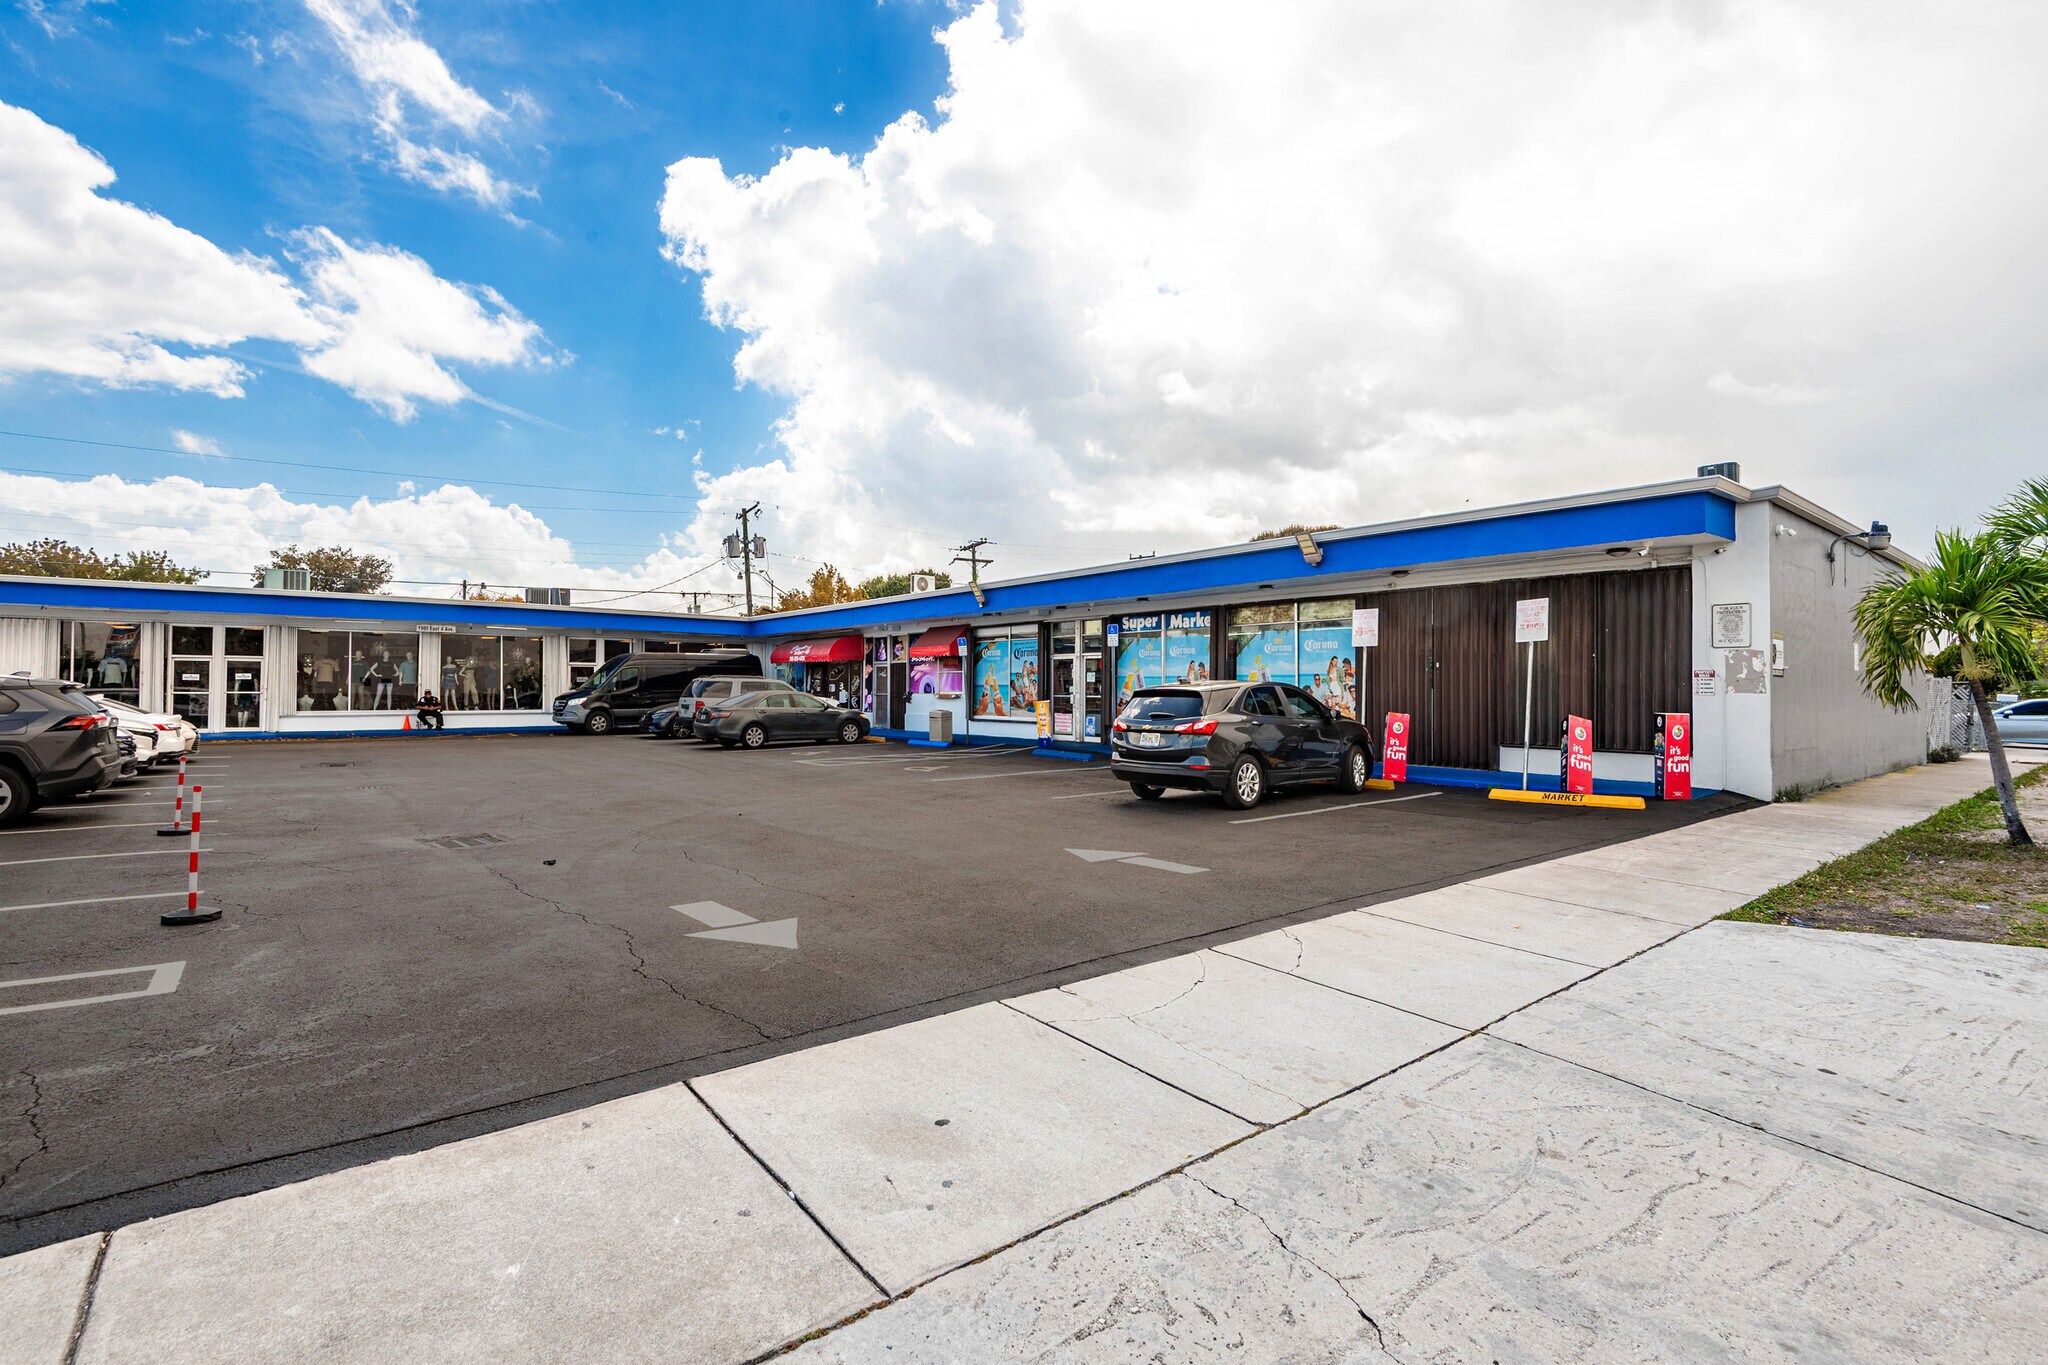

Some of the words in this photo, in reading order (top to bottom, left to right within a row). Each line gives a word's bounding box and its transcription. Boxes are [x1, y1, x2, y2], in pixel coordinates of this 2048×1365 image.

[1122, 616, 1158, 632] Super
[1264, 643, 1292, 654] Corona
[1304, 639, 1338, 652] Corona
[1014, 648, 1038, 660] Corona
[1138, 648, 1160, 658] Corona
[1170, 646, 1196, 657] Corona
[1390, 737, 1399, 746] it's
[1387, 747, 1406, 760] fun
[1573, 744, 1584, 754] it's
[1670, 746, 1681, 755] it's
[1570, 754, 1591, 771] fun
[1667, 758, 1689, 772] fun
[1542, 793, 1585, 802] MARKET
